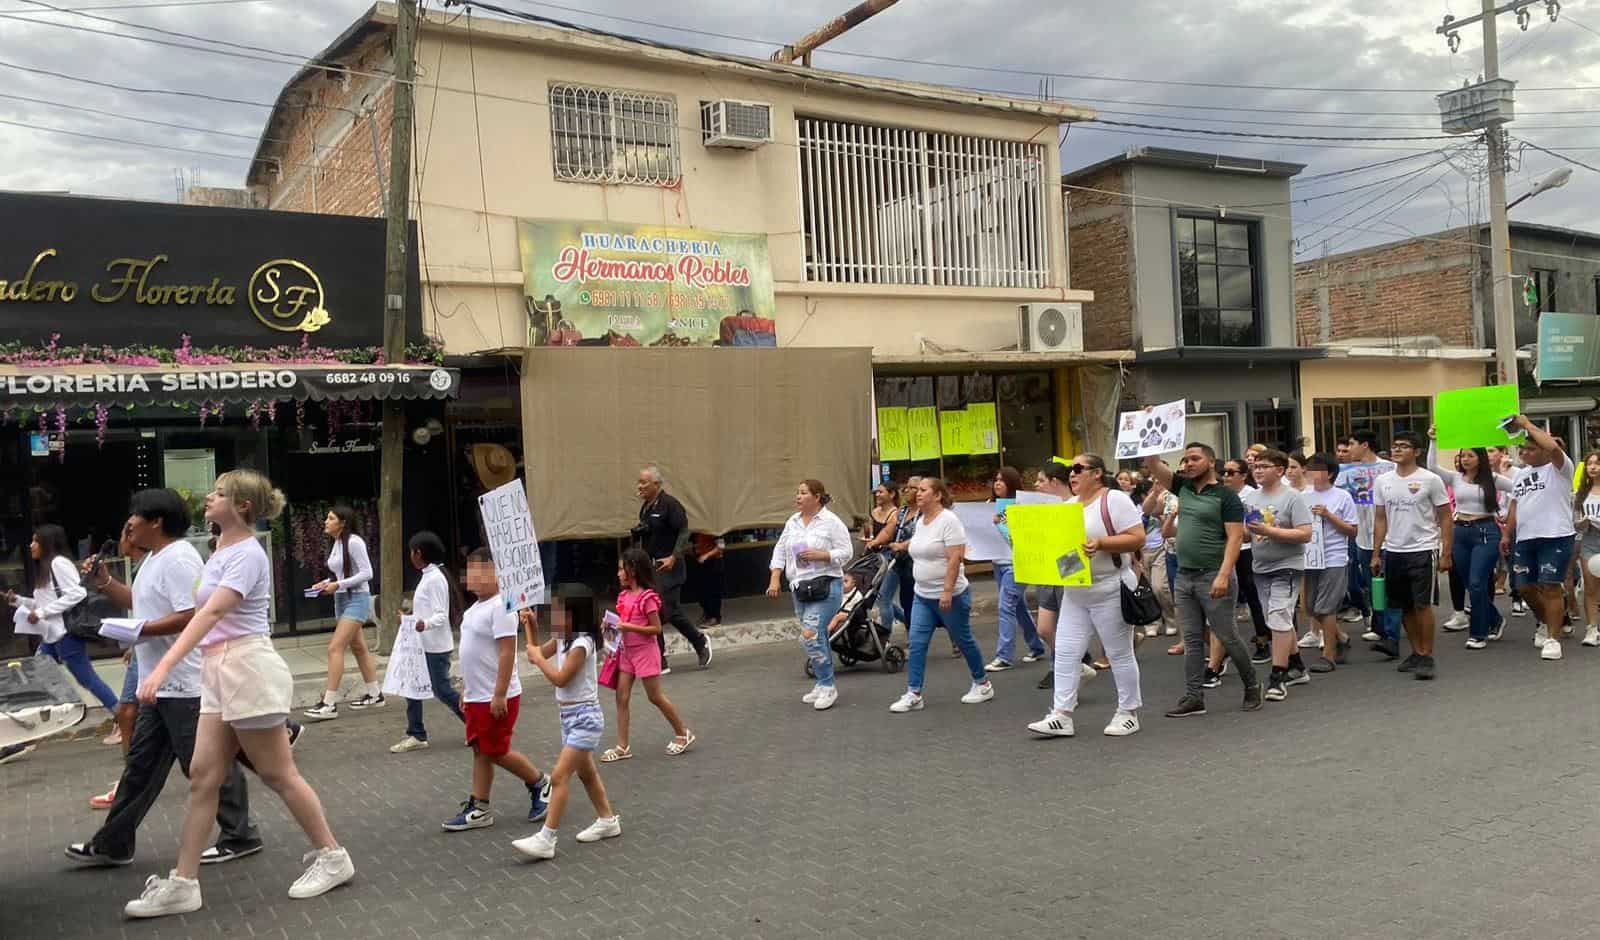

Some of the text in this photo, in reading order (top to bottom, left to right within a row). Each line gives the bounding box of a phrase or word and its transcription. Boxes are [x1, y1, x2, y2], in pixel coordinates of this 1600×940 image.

[584, 234, 721, 255] HUARACHERIA
[554, 248, 750, 288] Hermanos Robles
[161, 371, 297, 391] SENDERO
[326, 373, 410, 383] 6682 48 09 16
